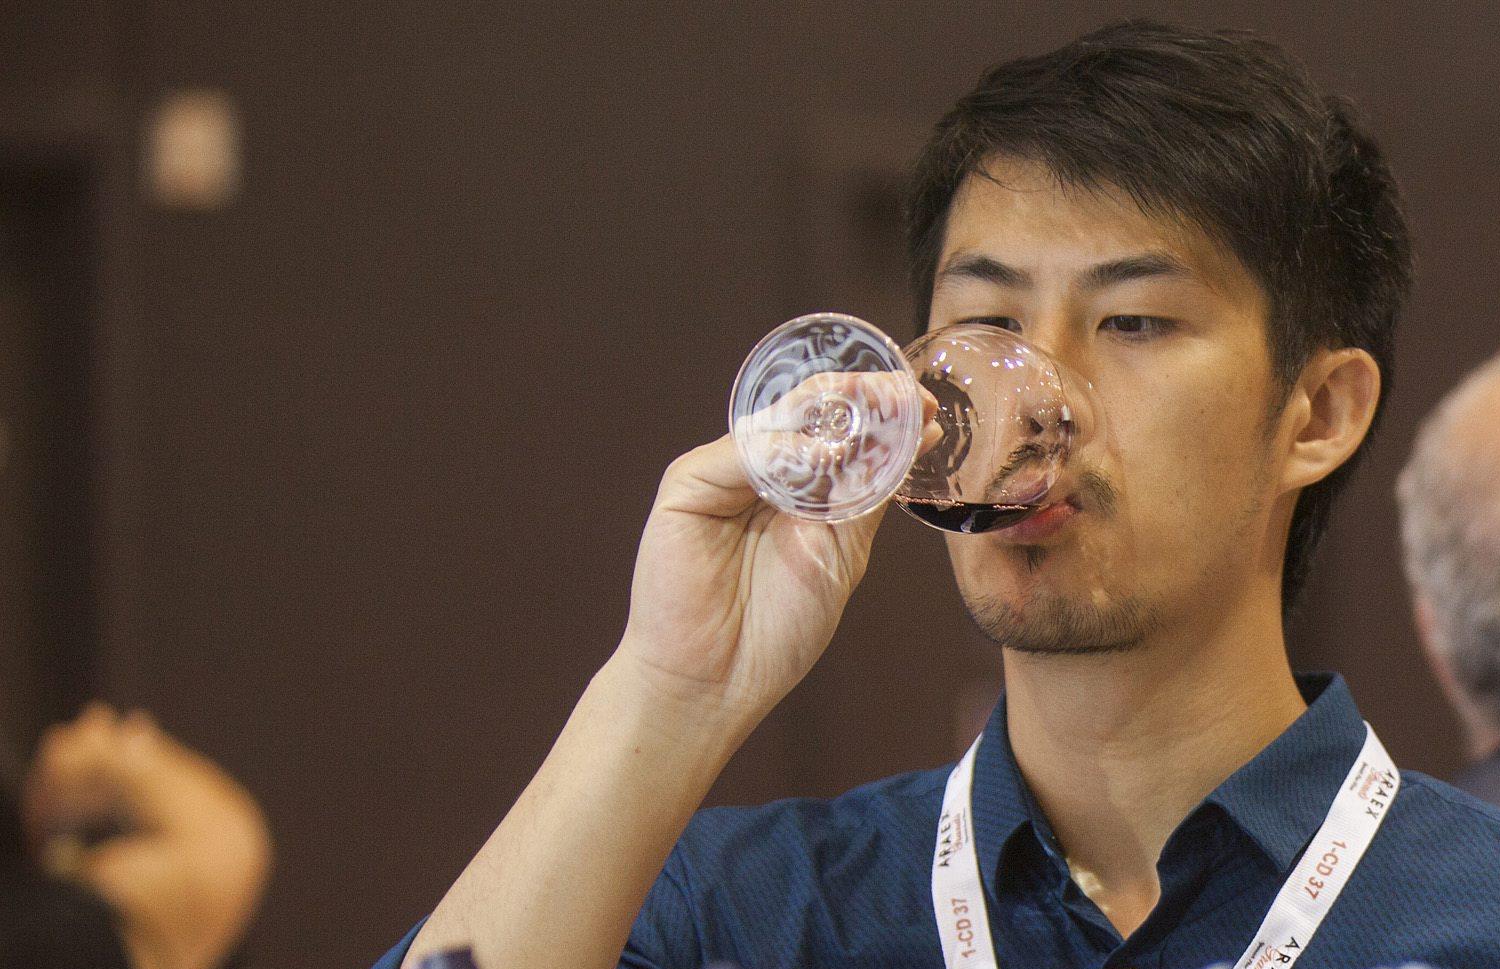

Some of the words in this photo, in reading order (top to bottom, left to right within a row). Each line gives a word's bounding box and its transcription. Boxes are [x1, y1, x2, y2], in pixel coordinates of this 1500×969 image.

[1316, 840, 1347, 877] 1-CD
[1304, 876, 1325, 900] 37
[951, 897, 969, 916] 37
[956, 918, 977, 958] 1-CD
